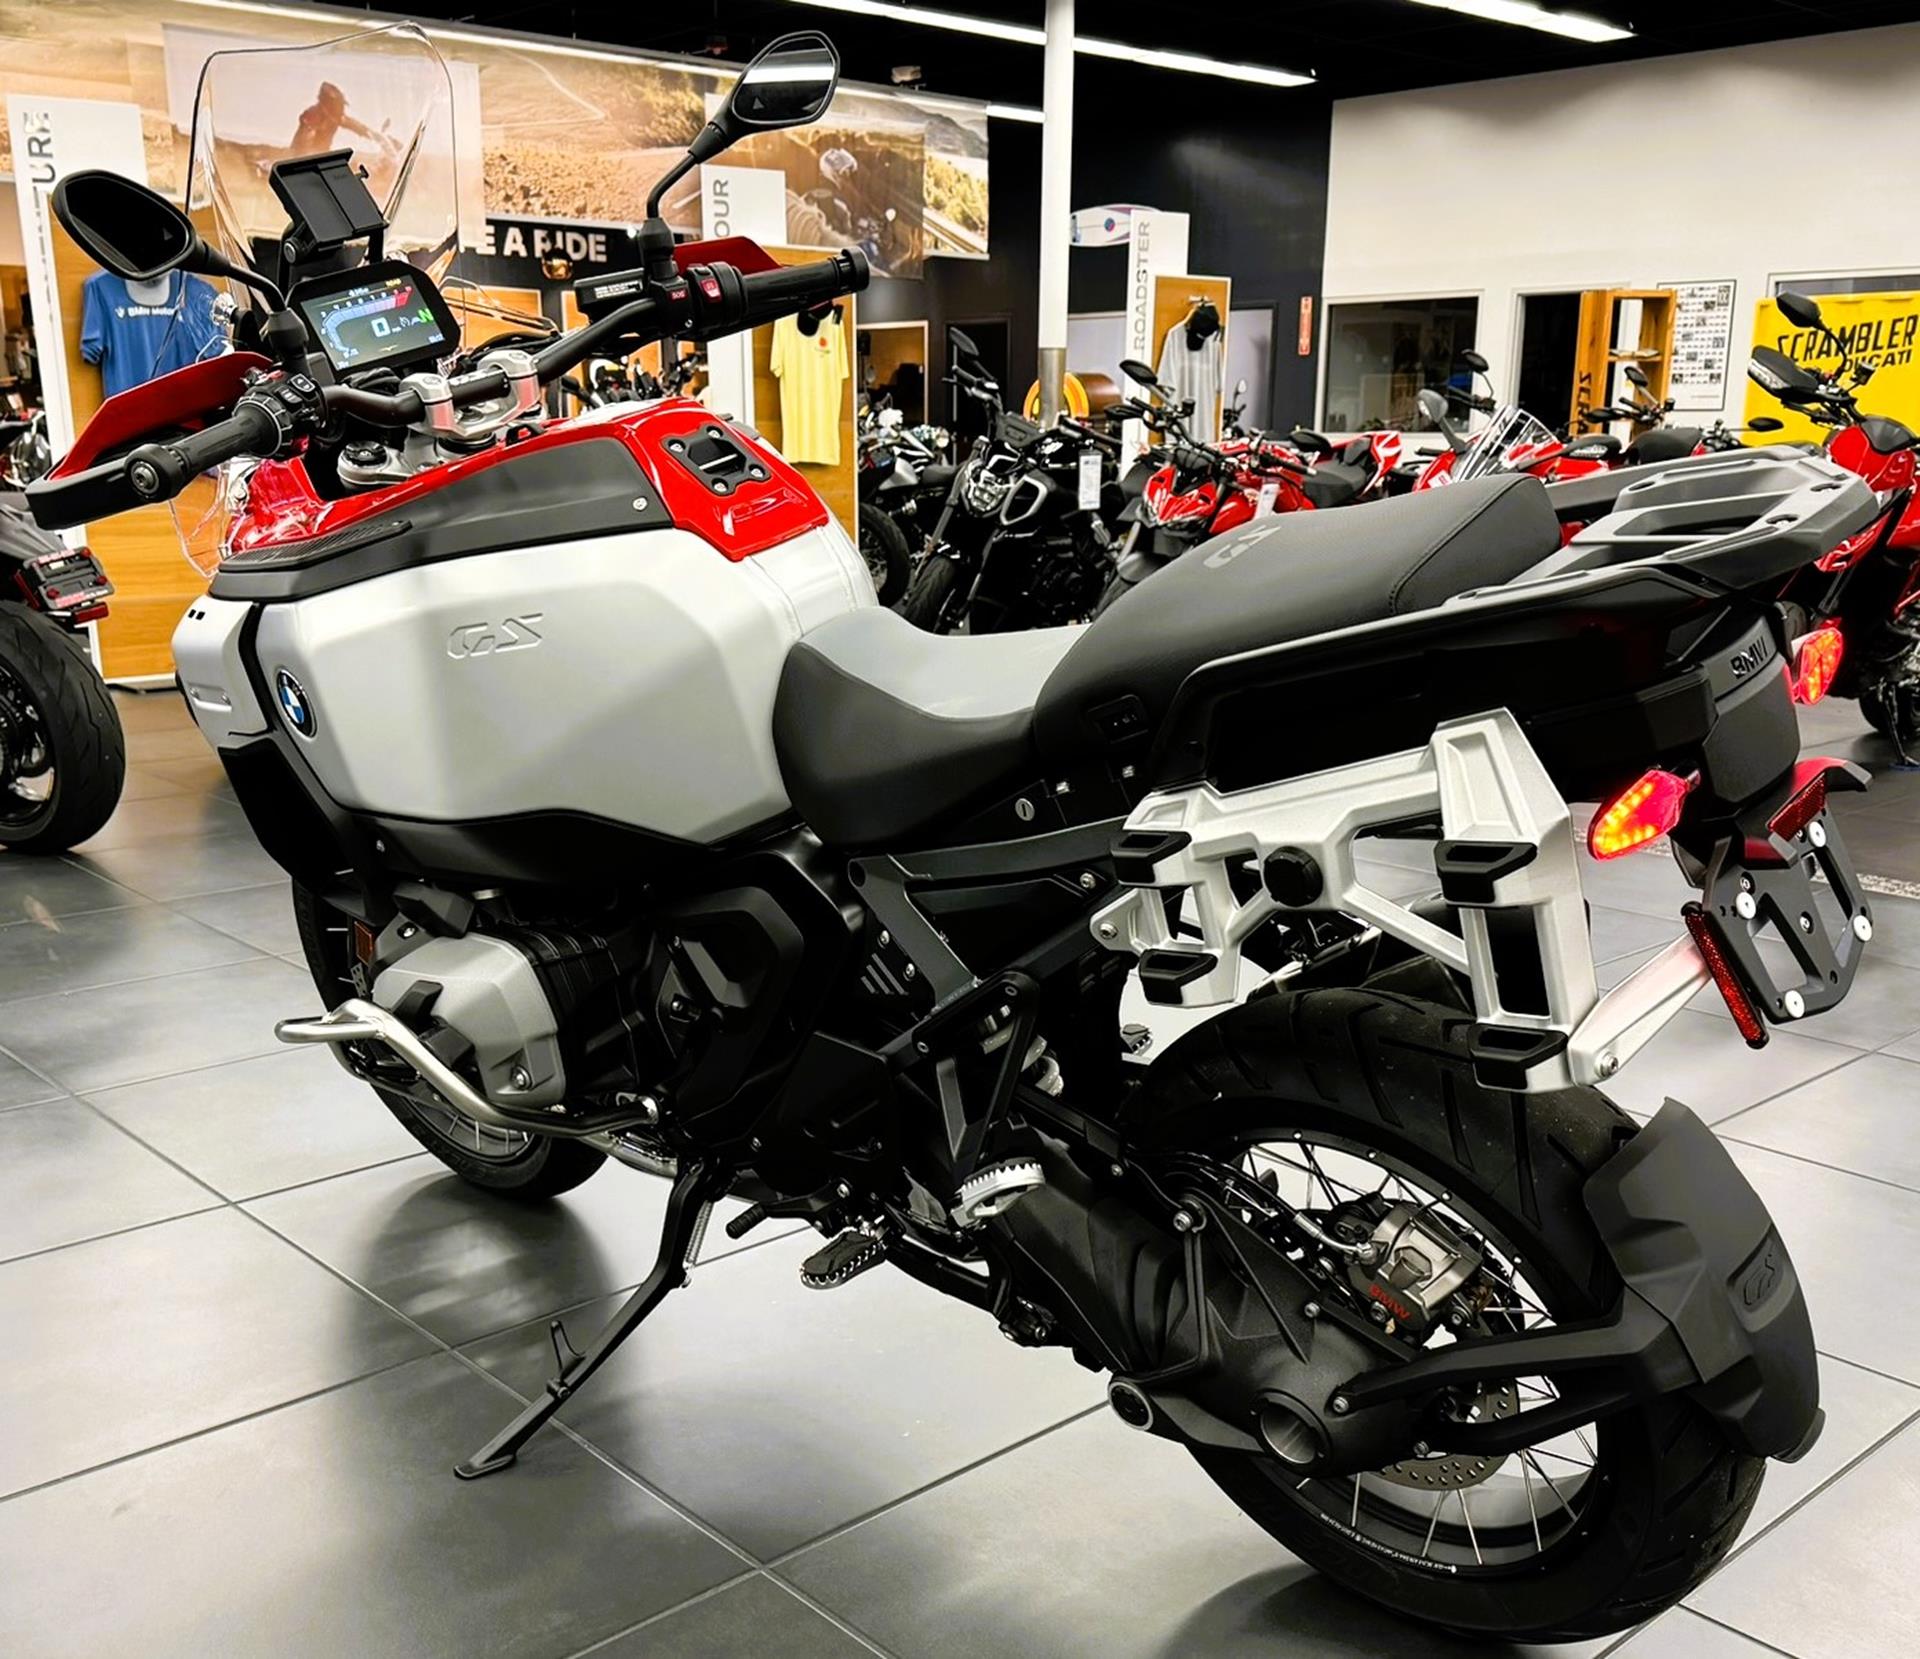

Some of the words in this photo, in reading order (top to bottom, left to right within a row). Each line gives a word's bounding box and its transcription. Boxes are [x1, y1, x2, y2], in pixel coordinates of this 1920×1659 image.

[713, 179, 731, 238] OUR
[503, 226, 528, 257] A
[533, 229, 607, 262] RIDE
[1134, 221, 1150, 352] ROADSTER
[151, 307, 176, 316] Motor
[418, 308, 434, 322] N
[1777, 314, 1919, 362] SCRAMBLER
[447, 612, 543, 660] GS
[1730, 636, 1768, 679] BMW
